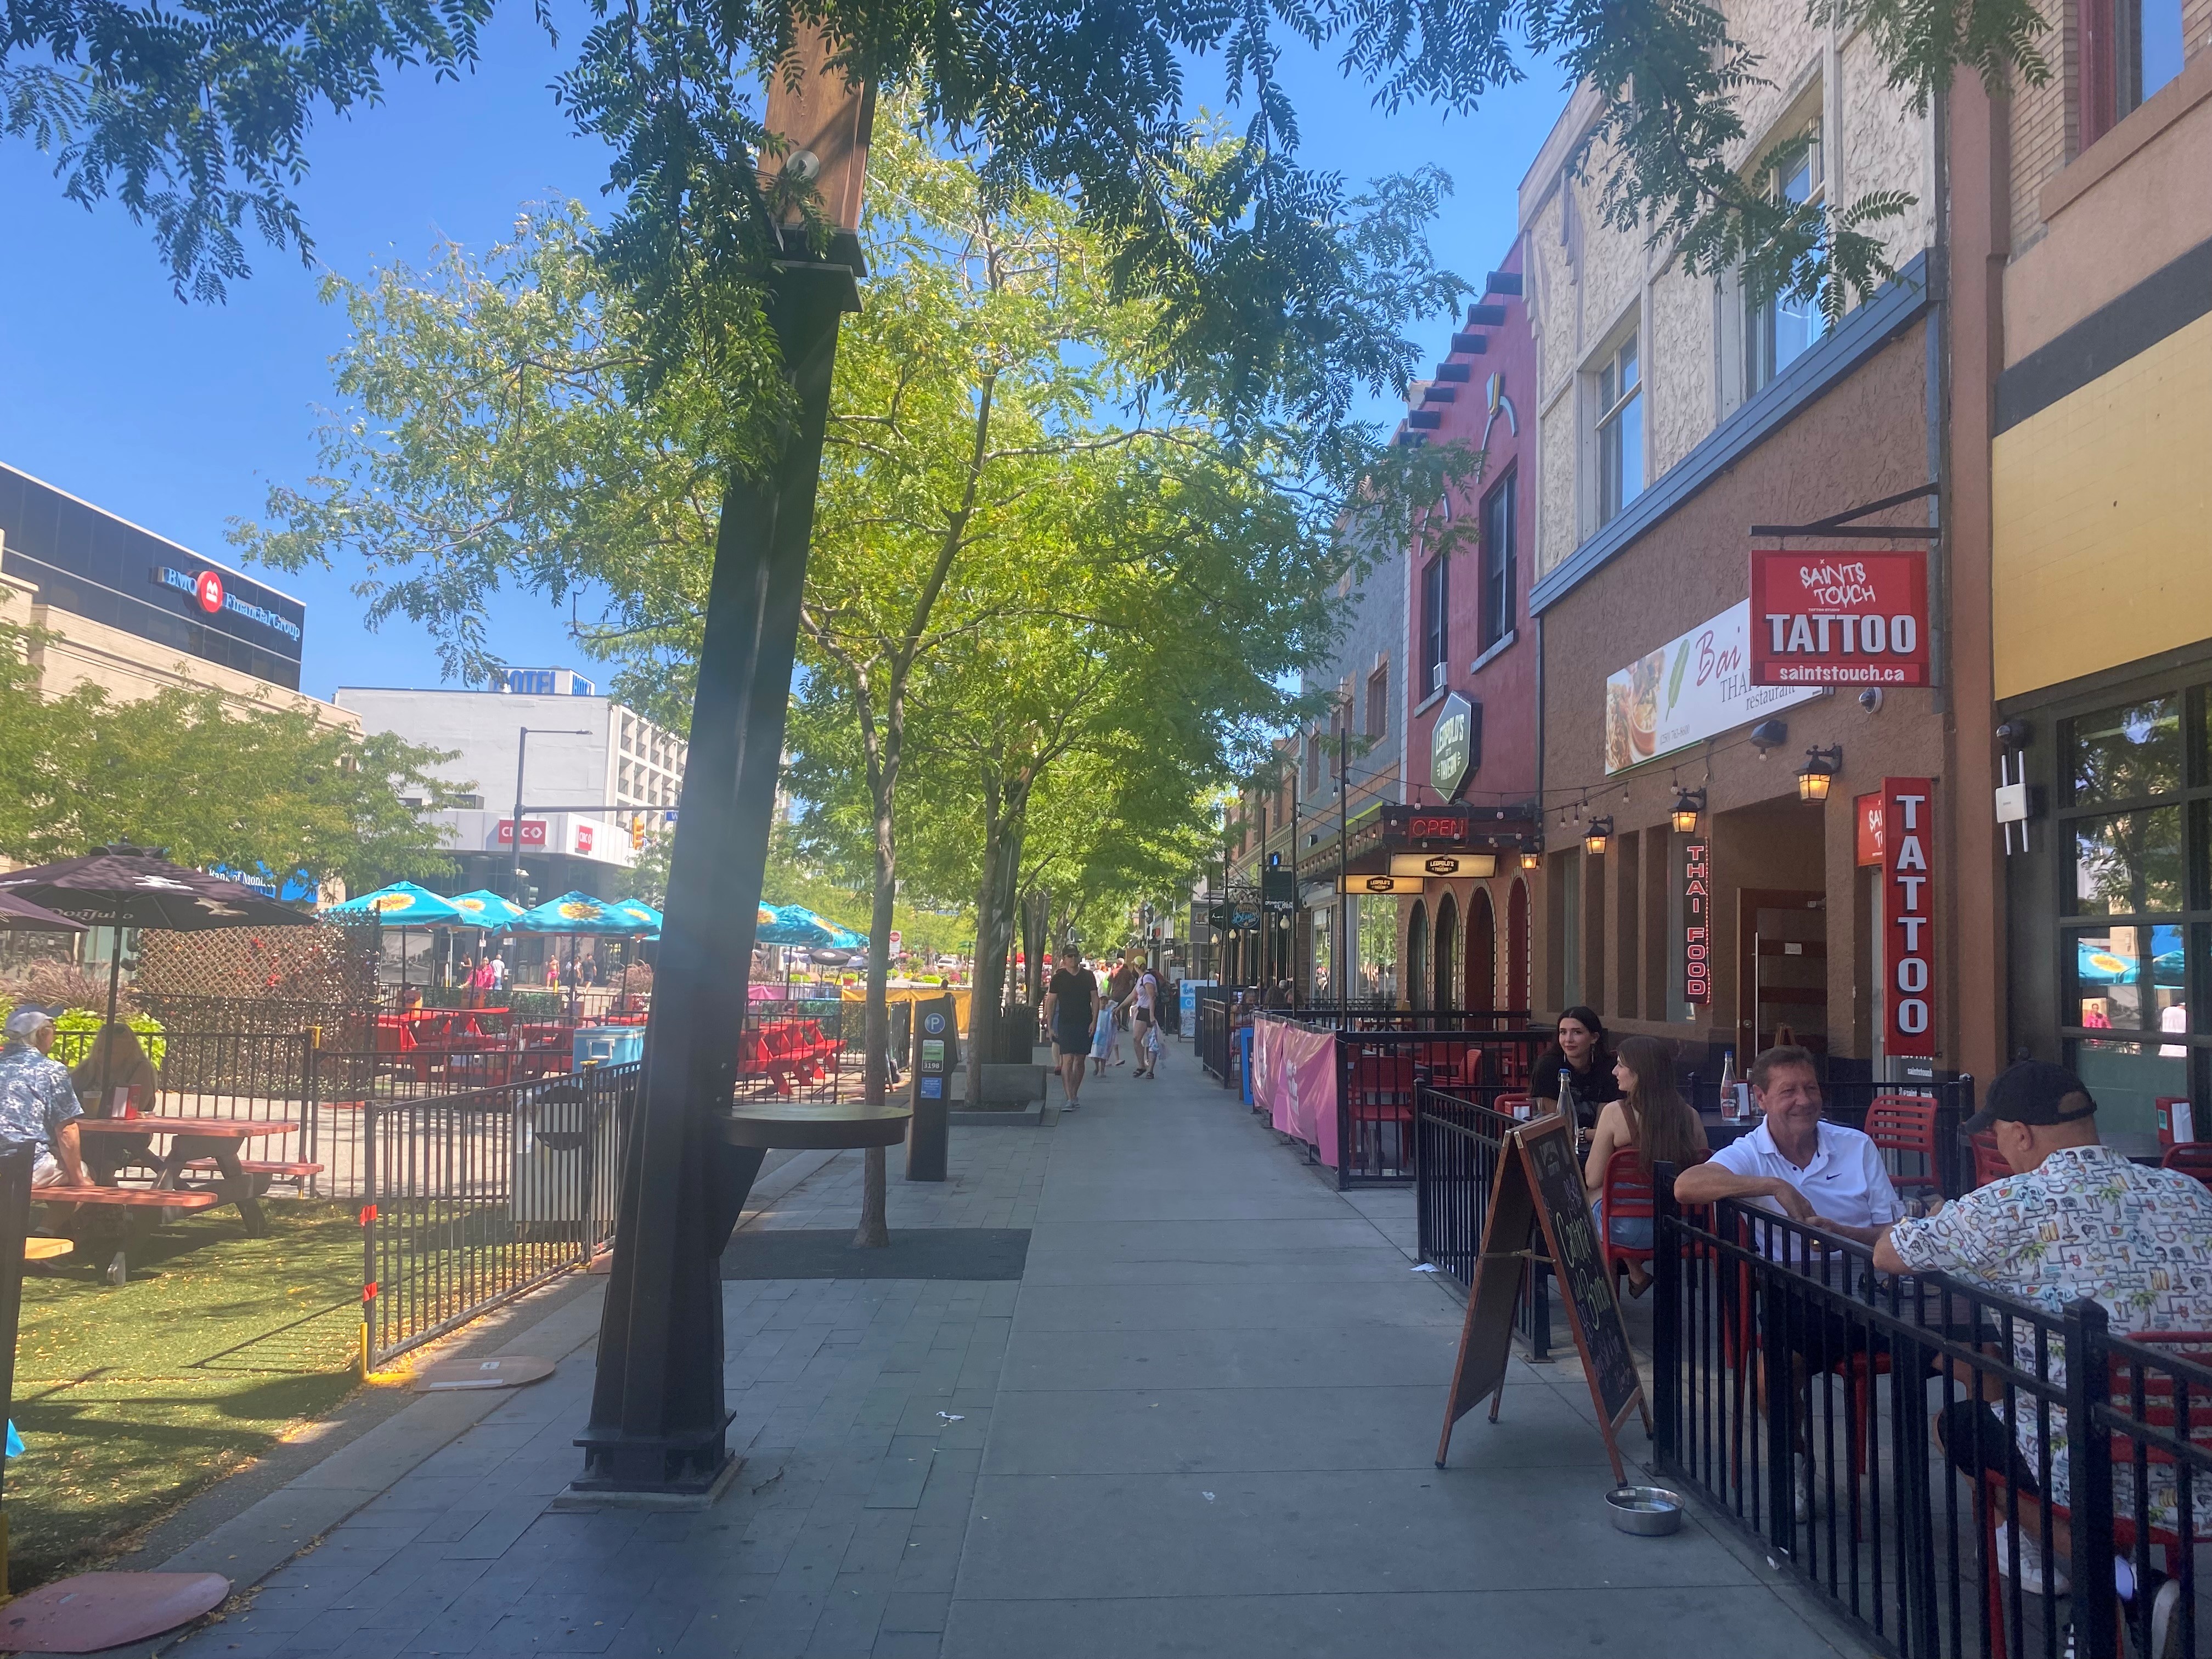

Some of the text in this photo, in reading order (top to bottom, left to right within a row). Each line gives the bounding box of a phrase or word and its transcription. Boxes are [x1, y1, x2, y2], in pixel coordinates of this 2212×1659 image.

[167, 567, 301, 642] BMO Financial Group
[1814, 584, 1876, 608] TOUCH
[1765, 614, 1917, 654] TATTOO
[1780, 664, 1905, 681] saintstouch.ca
[1746, 685, 1796, 711] restaurant
[1441, 751, 1457, 781] TAVERN
[501, 826, 529, 838] CIC
[579, 831, 588, 844] CIBC
[82, 909, 134, 921] Julo
[1685, 845, 1707, 996] THAI FOOD
[1895, 794, 1929, 1034] TATTOO
[931, 1017, 940, 1030] P
